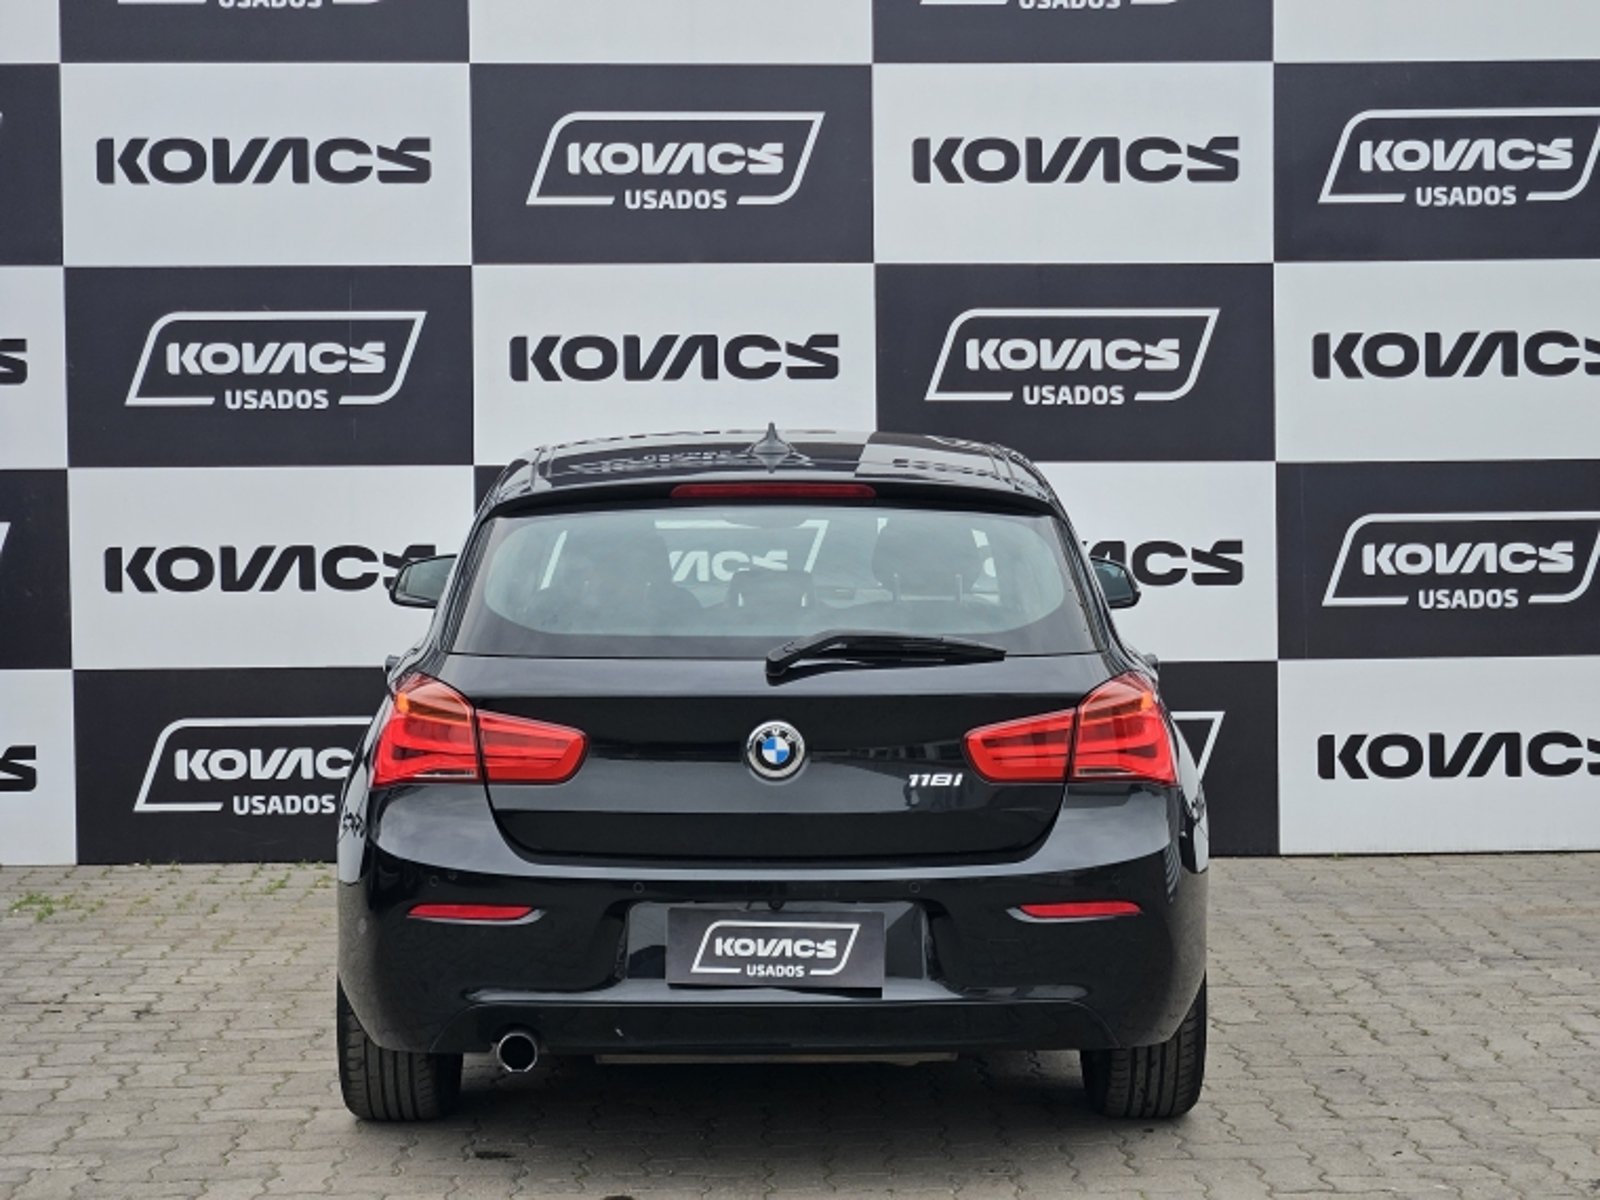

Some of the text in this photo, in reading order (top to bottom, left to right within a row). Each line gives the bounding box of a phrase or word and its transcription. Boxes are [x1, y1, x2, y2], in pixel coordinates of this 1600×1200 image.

[97, 138, 431, 184] KOVACS
[567, 142, 784, 174] KOVACS
[913, 136, 1239, 183] KOVACS
[1359, 138, 1573, 171] KOVACS
[625, 190, 726, 209] USADOS
[1416, 186, 1516, 206] USADOS
[167, 342, 386, 374] KOVACS
[510, 334, 839, 381] KOVACS
[966, 339, 1179, 370] KOVACS
[1313, 331, 1600, 379] KOVAC
[225, 390, 328, 409] USADOS
[1024, 386, 1124, 405] USADOS
[1362, 541, 1573, 574] KOVACS
[1418, 588, 1518, 608] USADOS
[175, 748, 354, 781] KOVAC
[1318, 732, 1600, 779] KOVAC
[233, 795, 336, 815] USADOS
[714, 938, 837, 958] KOVACS
[746, 964, 805, 977] USADOS
